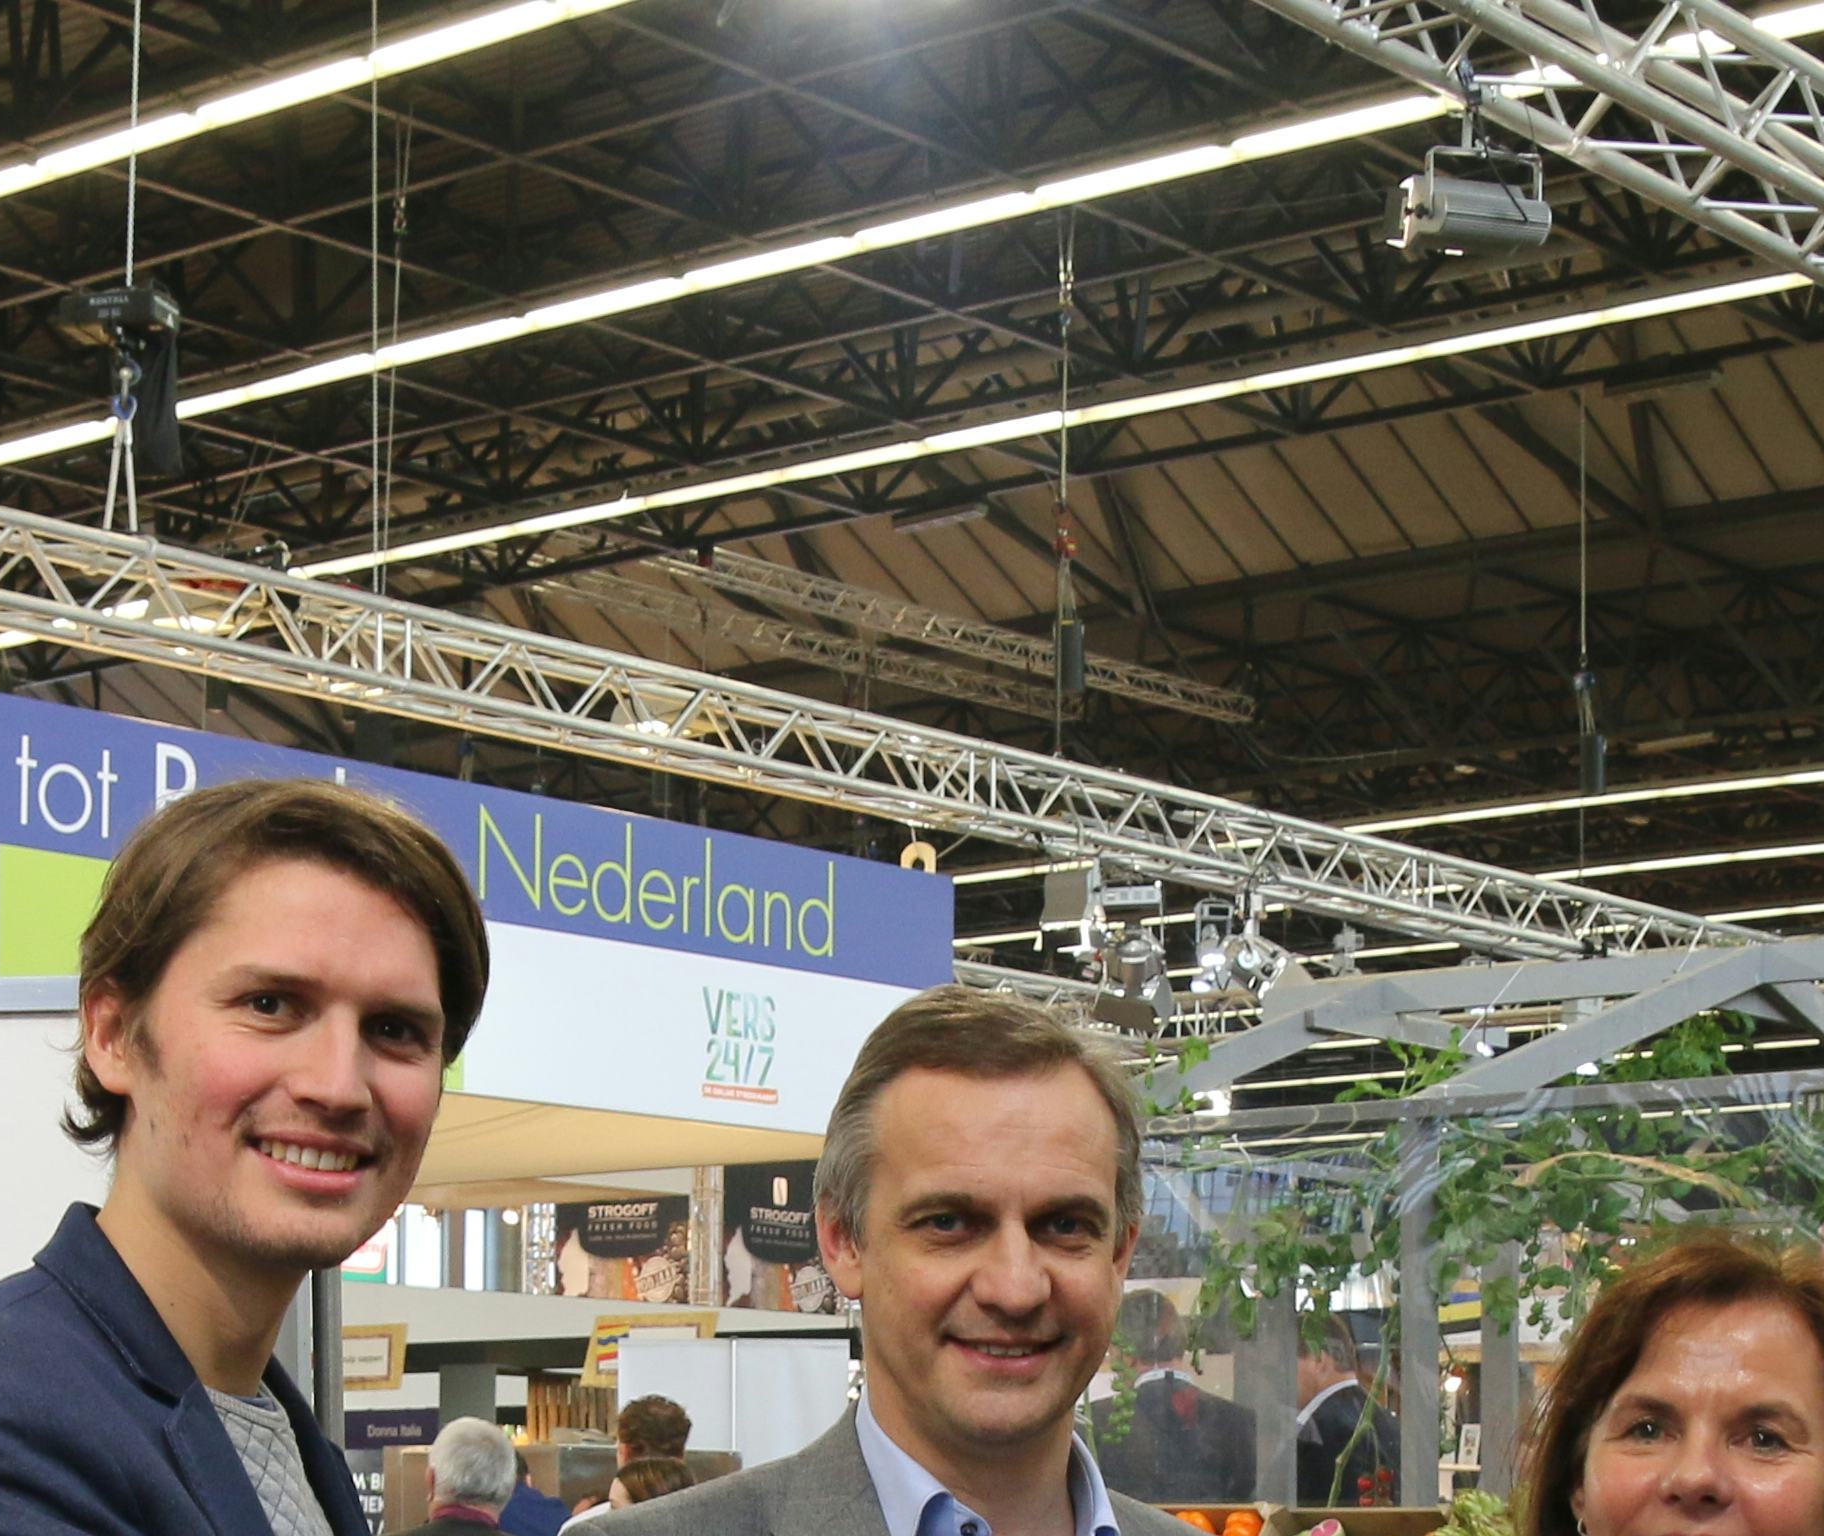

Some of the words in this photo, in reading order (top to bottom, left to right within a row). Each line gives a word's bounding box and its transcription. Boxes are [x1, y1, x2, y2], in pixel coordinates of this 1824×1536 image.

[15, 735, 118, 838] tot
[478, 803, 836, 958] Nederland
[702, 986, 776, 1042] VERS
[705, 1037, 775, 1086] 24/7
[588, 1202, 658, 1219] STROGOFF
[749, 1206, 811, 1225] STROGOFF
